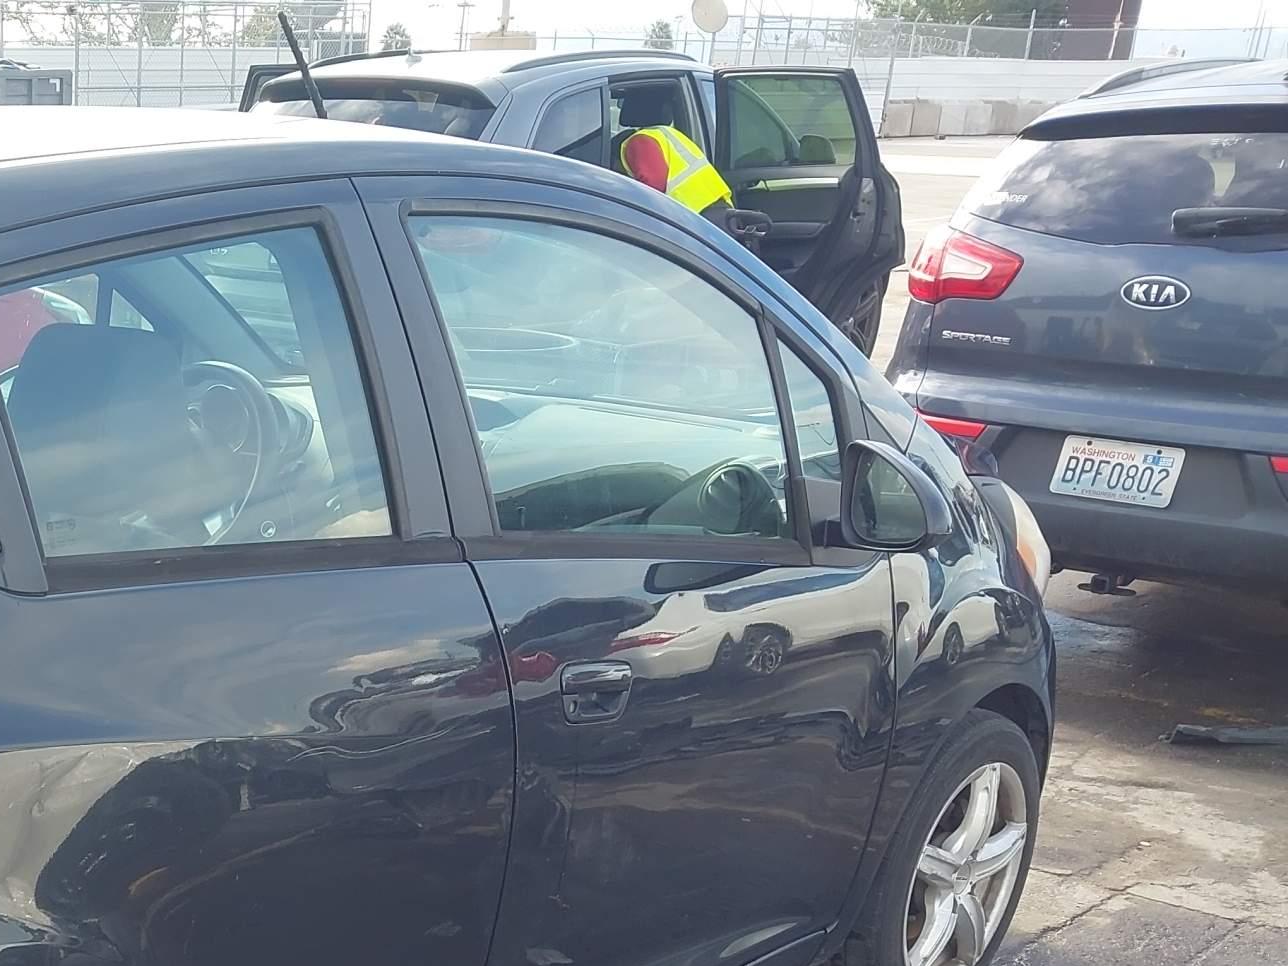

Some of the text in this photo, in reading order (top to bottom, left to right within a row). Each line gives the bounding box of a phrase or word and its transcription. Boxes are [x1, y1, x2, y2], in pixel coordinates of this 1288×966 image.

[1131, 283, 1176, 303] KIA
[942, 330, 1011, 345] SPORTAGE
[1071, 446, 1137, 462] WASHINGTON
[1061, 455, 1170, 496] BPF0802
